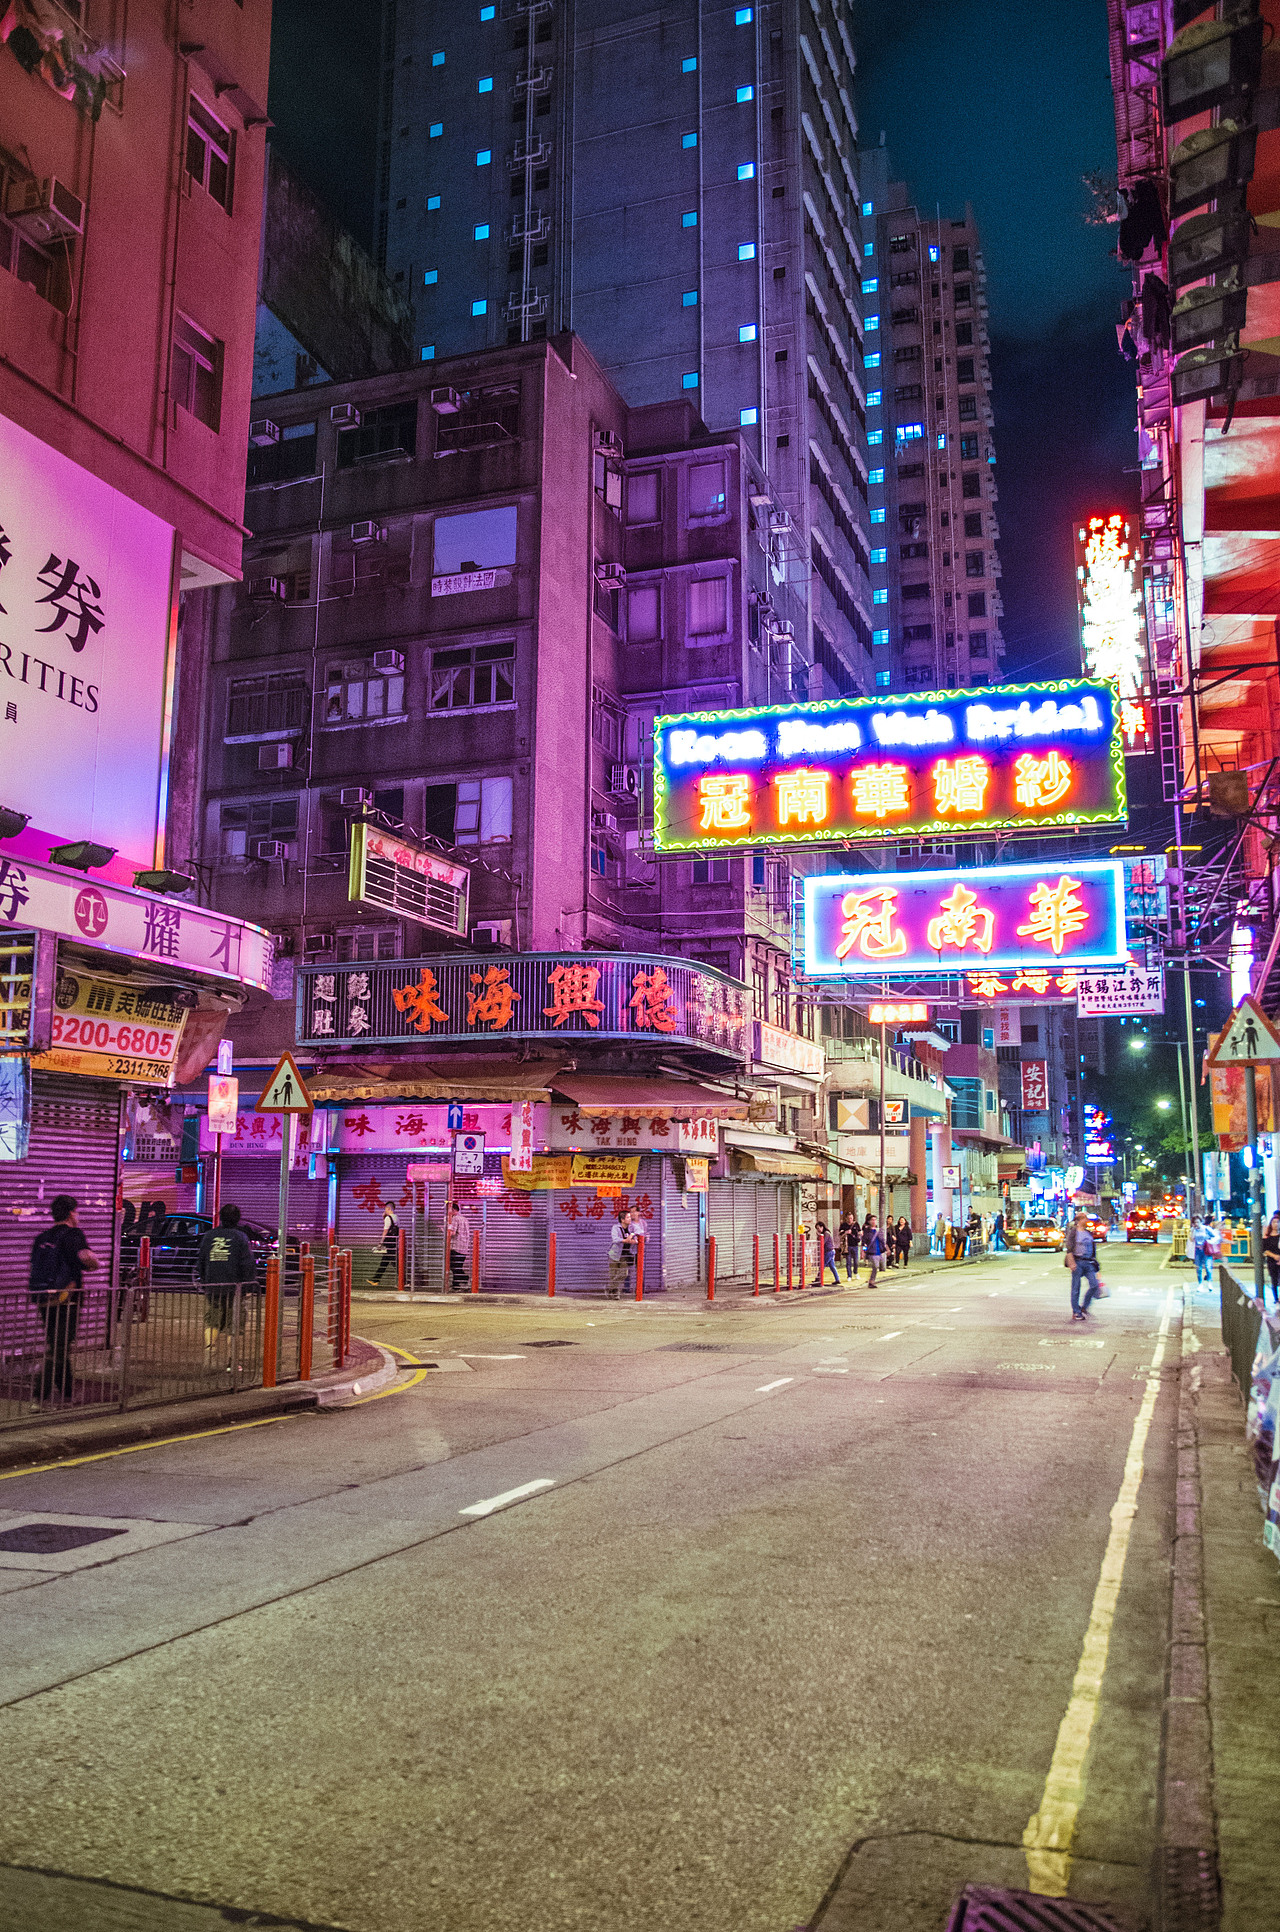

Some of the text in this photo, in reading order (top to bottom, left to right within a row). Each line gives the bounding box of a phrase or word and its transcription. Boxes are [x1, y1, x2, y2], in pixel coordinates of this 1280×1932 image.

[699, 750, 1073, 831] 冠南華婚紗
[835, 874, 1091, 960] 冠南華
[1079, 976, 1160, 995] 張錫江診所
[1024, 1063, 1045, 1099] 安記
[596, 1136, 637, 1146] TAK HING
